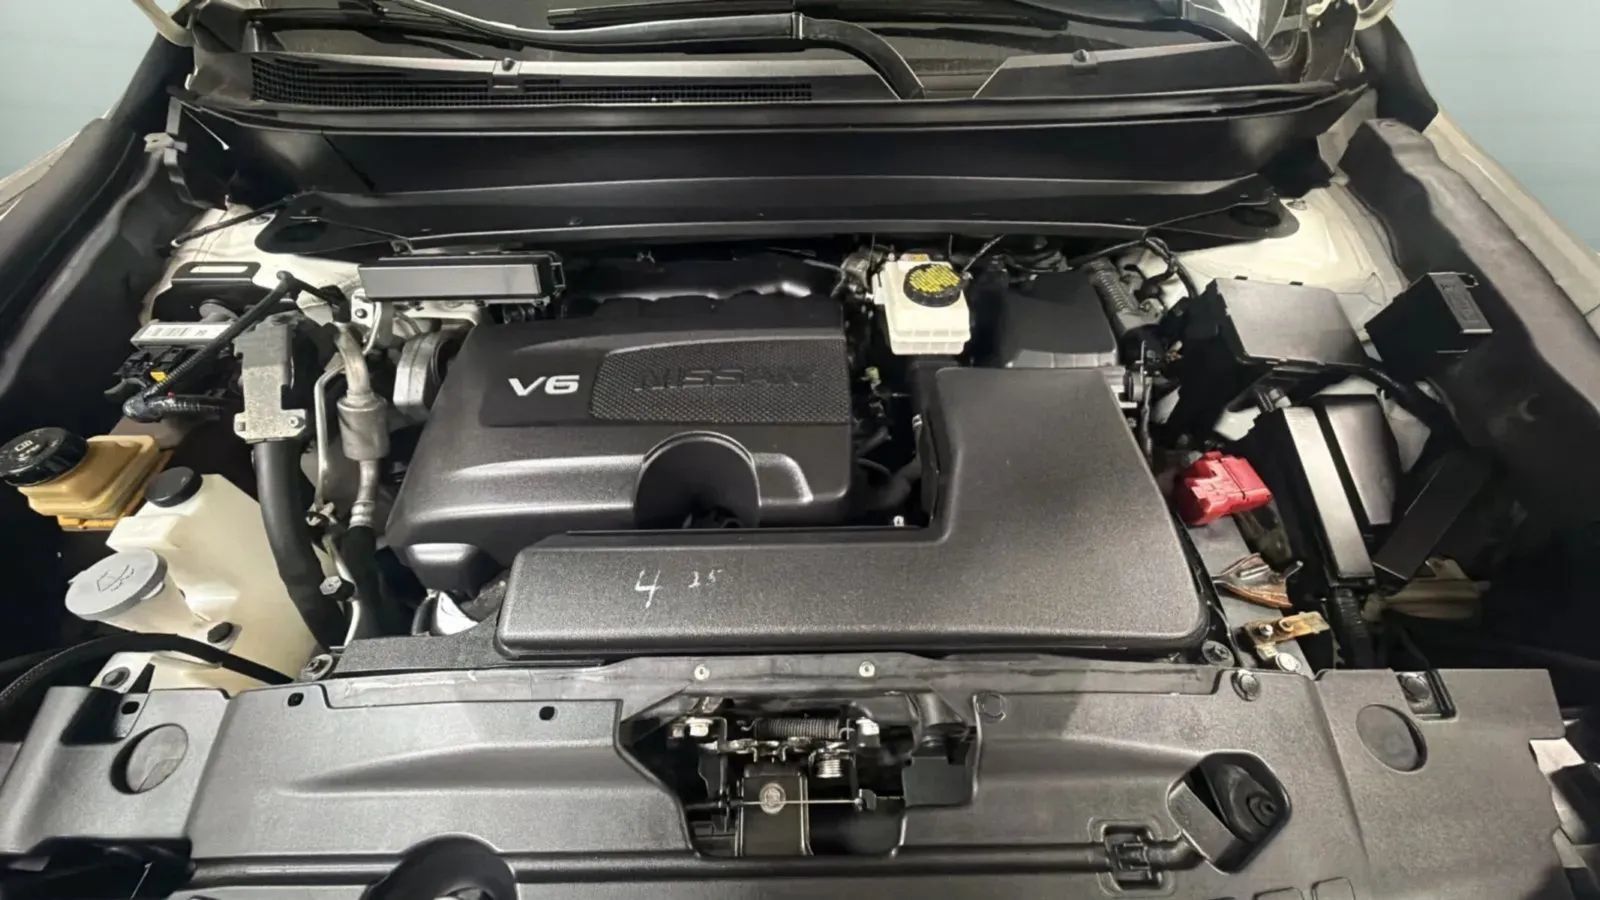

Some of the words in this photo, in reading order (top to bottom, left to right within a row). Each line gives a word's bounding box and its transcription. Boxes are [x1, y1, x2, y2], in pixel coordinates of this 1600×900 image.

[508, 374, 580, 397] V6
[634, 368, 817, 394] NISSAN
[634, 568, 663, 608] 4
